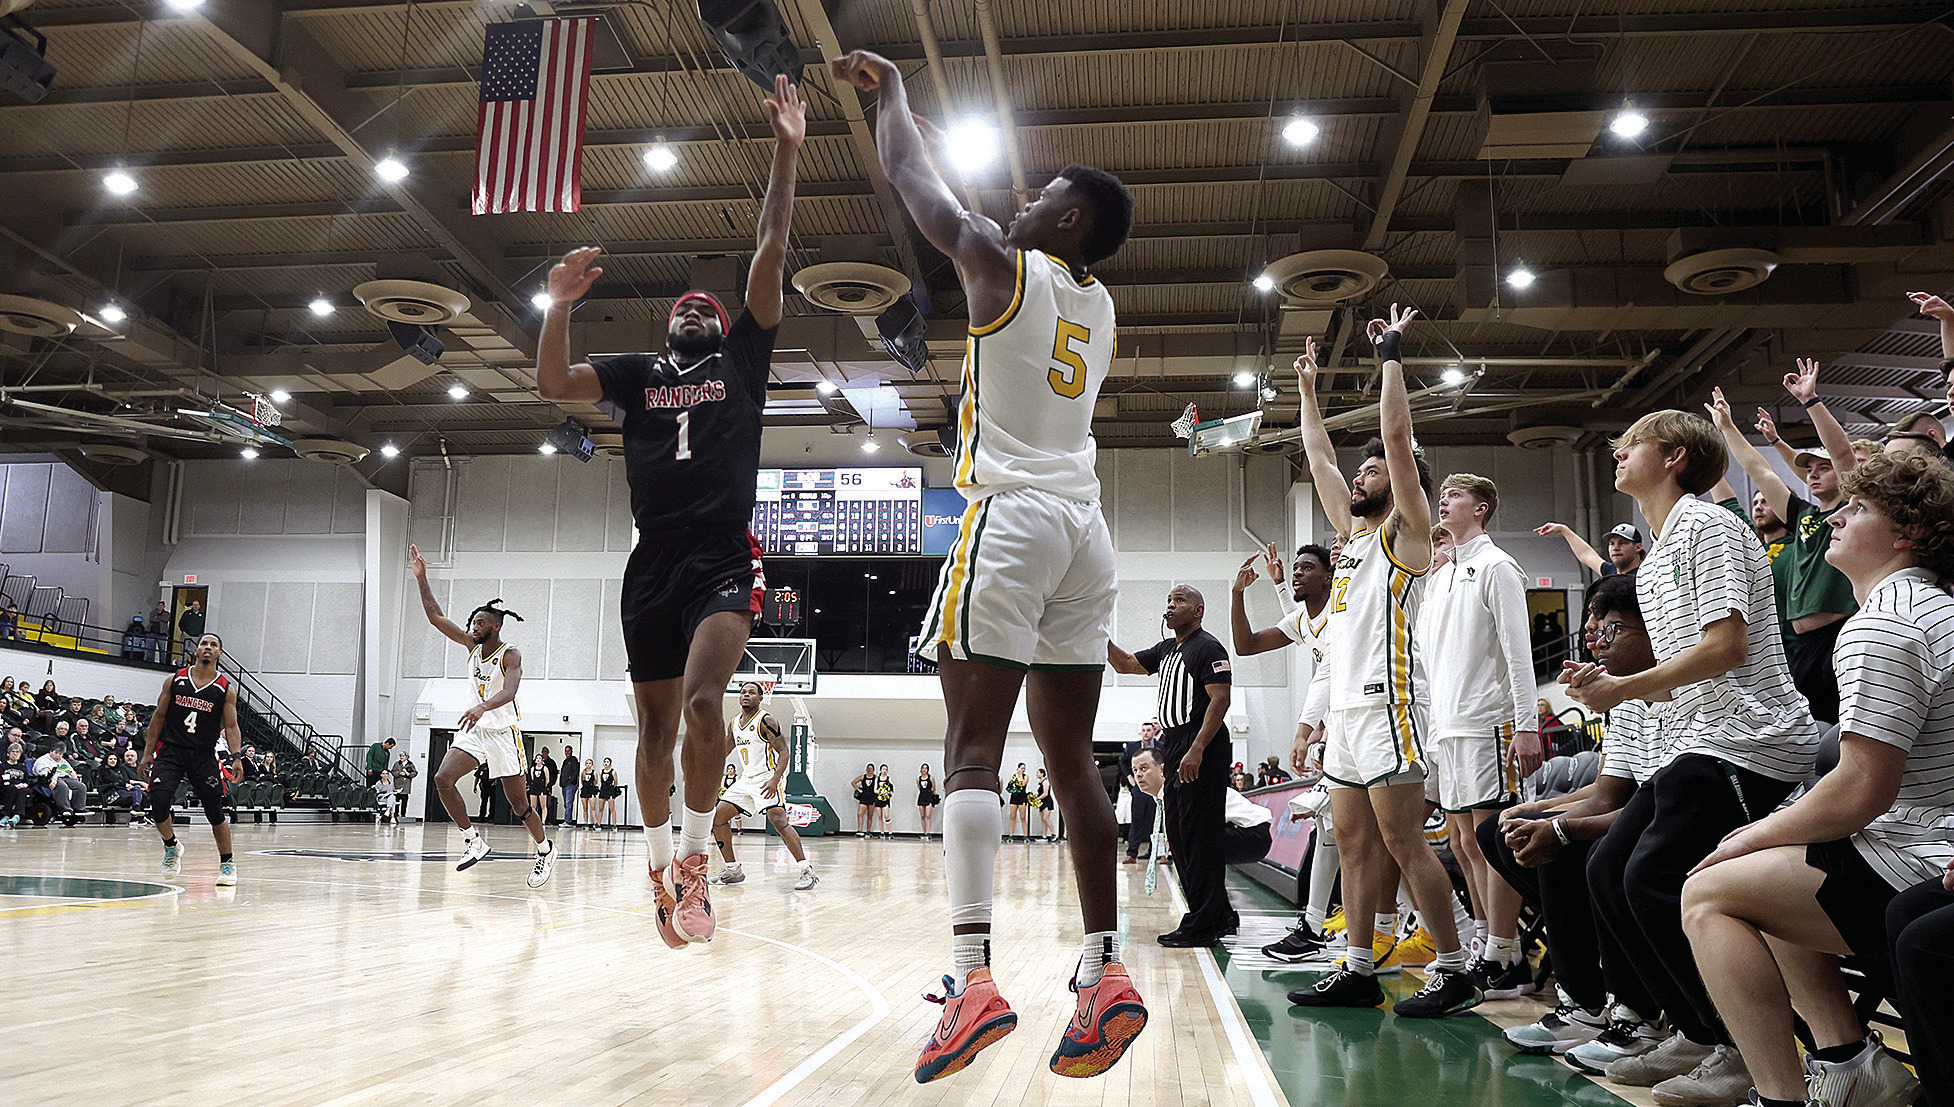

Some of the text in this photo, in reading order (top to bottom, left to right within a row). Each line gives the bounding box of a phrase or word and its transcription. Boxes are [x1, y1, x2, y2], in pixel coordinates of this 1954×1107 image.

[1047, 316, 1091, 400] 5
[645, 380, 726, 410] RANGERS
[676, 411, 692, 460] 1
[841, 473, 862, 486] 56
[775, 591, 798, 603] 2:05
[1331, 576, 1351, 614] 12
[175, 694, 215, 713] RANGERS
[184, 711, 198, 734] 4
[740, 748, 749, 766] 0
[794, 726, 803, 773] BISON
